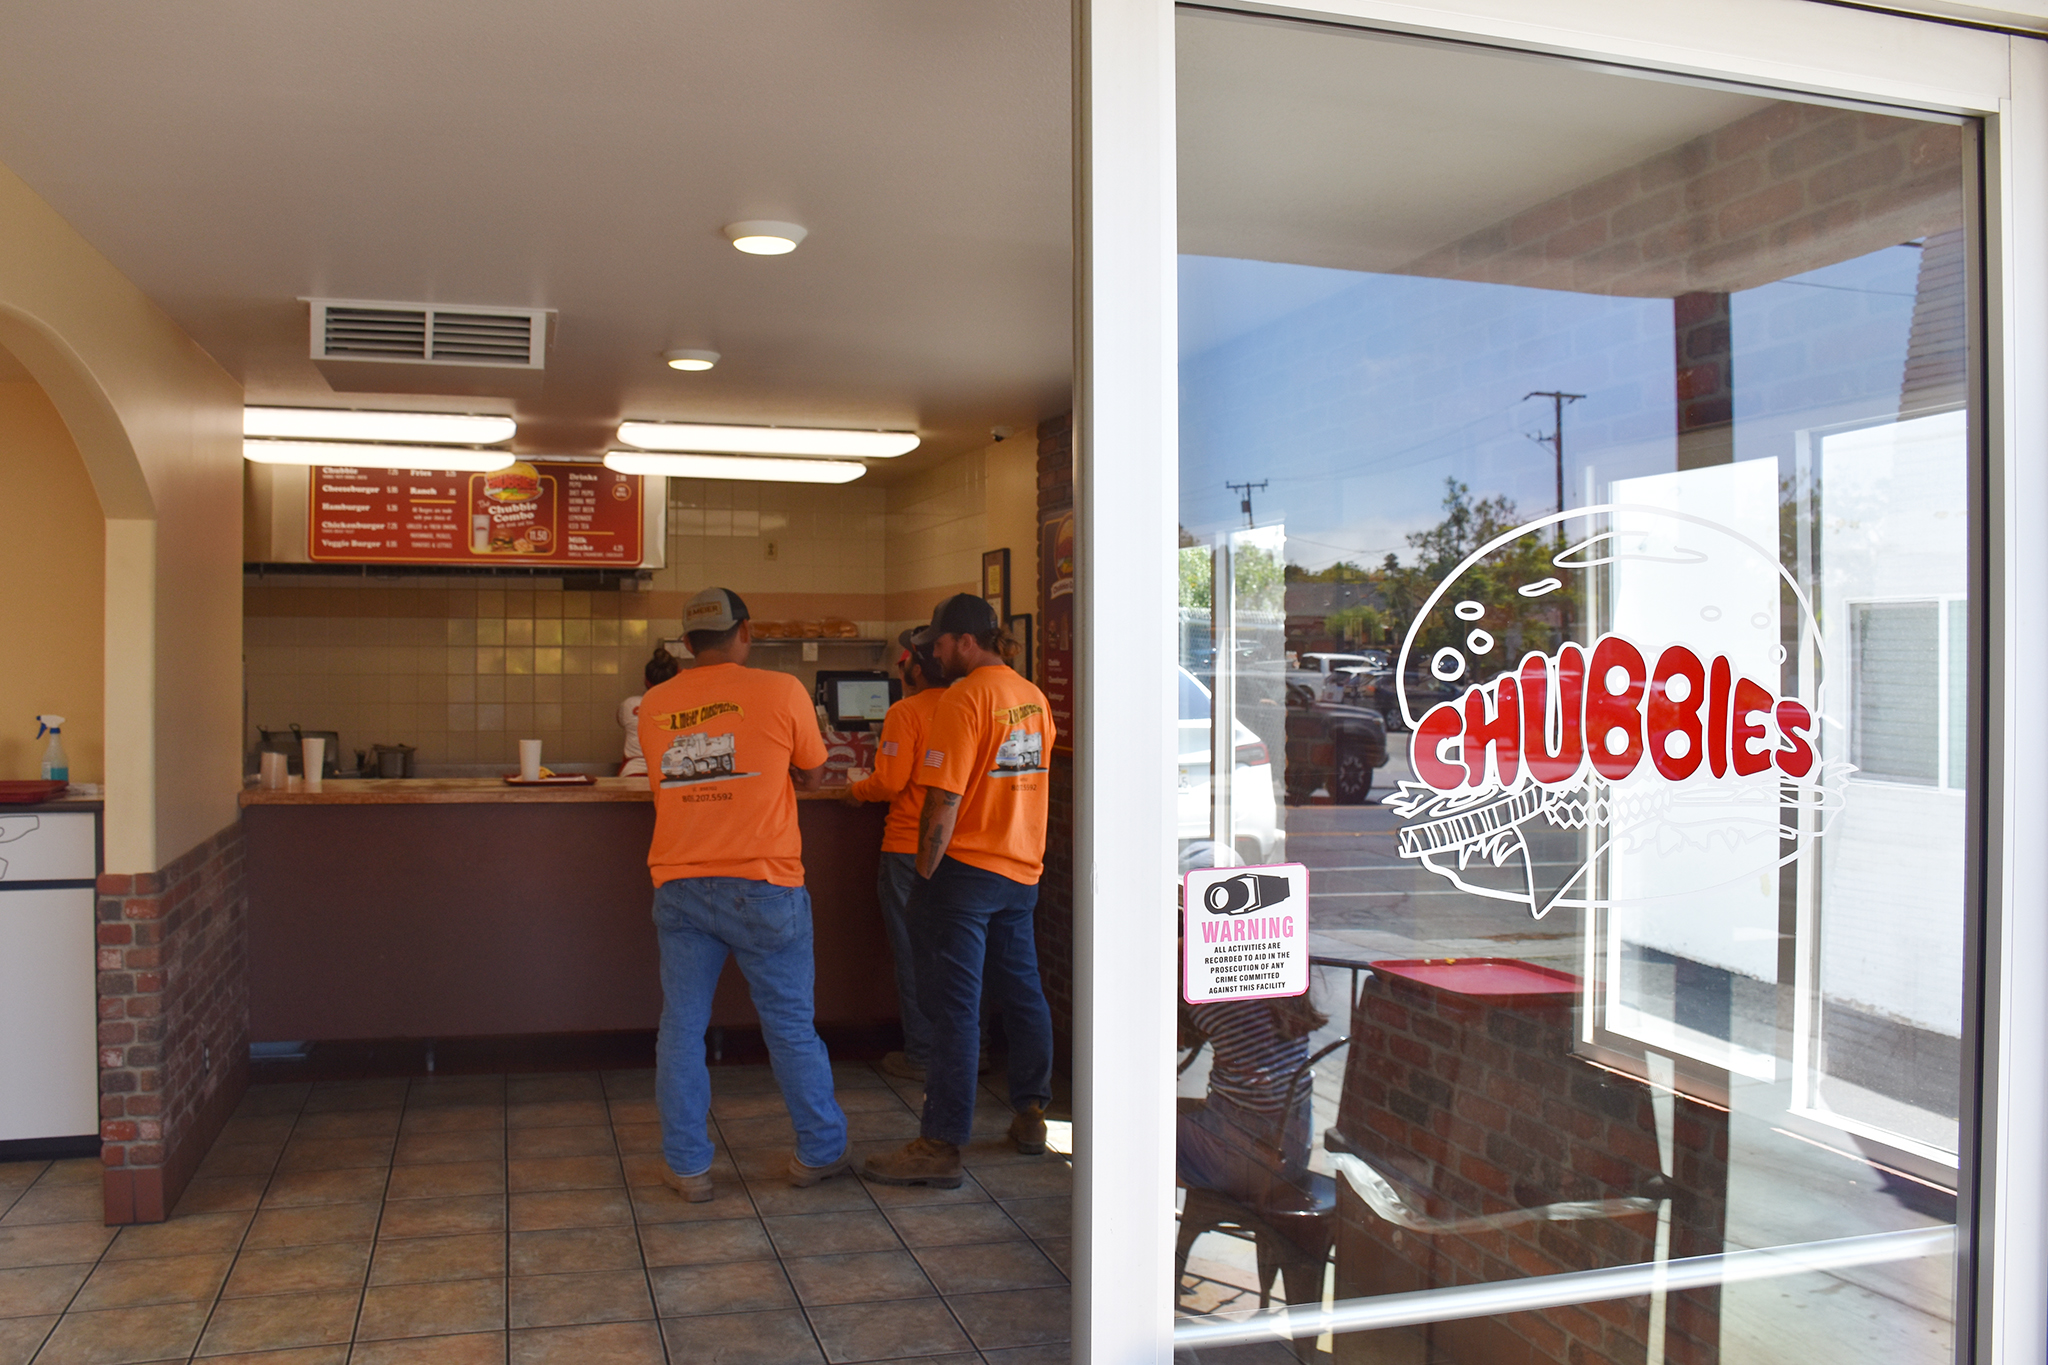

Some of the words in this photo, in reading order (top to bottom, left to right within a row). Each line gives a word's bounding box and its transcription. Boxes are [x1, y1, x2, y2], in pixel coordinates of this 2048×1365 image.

[410, 469, 432, 477] Fries
[569, 473, 598, 481] Drinks
[322, 484, 380, 494] Cheeseburger
[410, 487, 437, 495] Ranch
[322, 502, 371, 512] Hamburger
[488, 502, 537, 515] Chubbie
[493, 511, 535, 523] Combo
[321, 521, 386, 531] Chickenburger
[529, 530, 548, 541] 11.50
[568, 536, 587, 544] Milk
[321, 539, 350, 548] Veggie
[351, 539, 382, 549] Burger
[1412, 634, 1815, 792] CHUBBIES
[1201, 916, 1294, 943] WARNING
[1228, 943, 1266, 953] ACTIVITIES
[1204, 955, 1242, 964] RECORDED
[1244, 954, 1253, 962] TO
[1254, 953, 1267, 961] AID
[1277, 951, 1290, 959] THE
[1210, 964, 1259, 974] PROSECUTION
[1215, 975, 1238, 984] CRIME
[1239, 972, 1280, 982] COMMITTED
[1209, 985, 1238, 994] AGAINST
[1256, 982, 1286, 990] FACILITY
